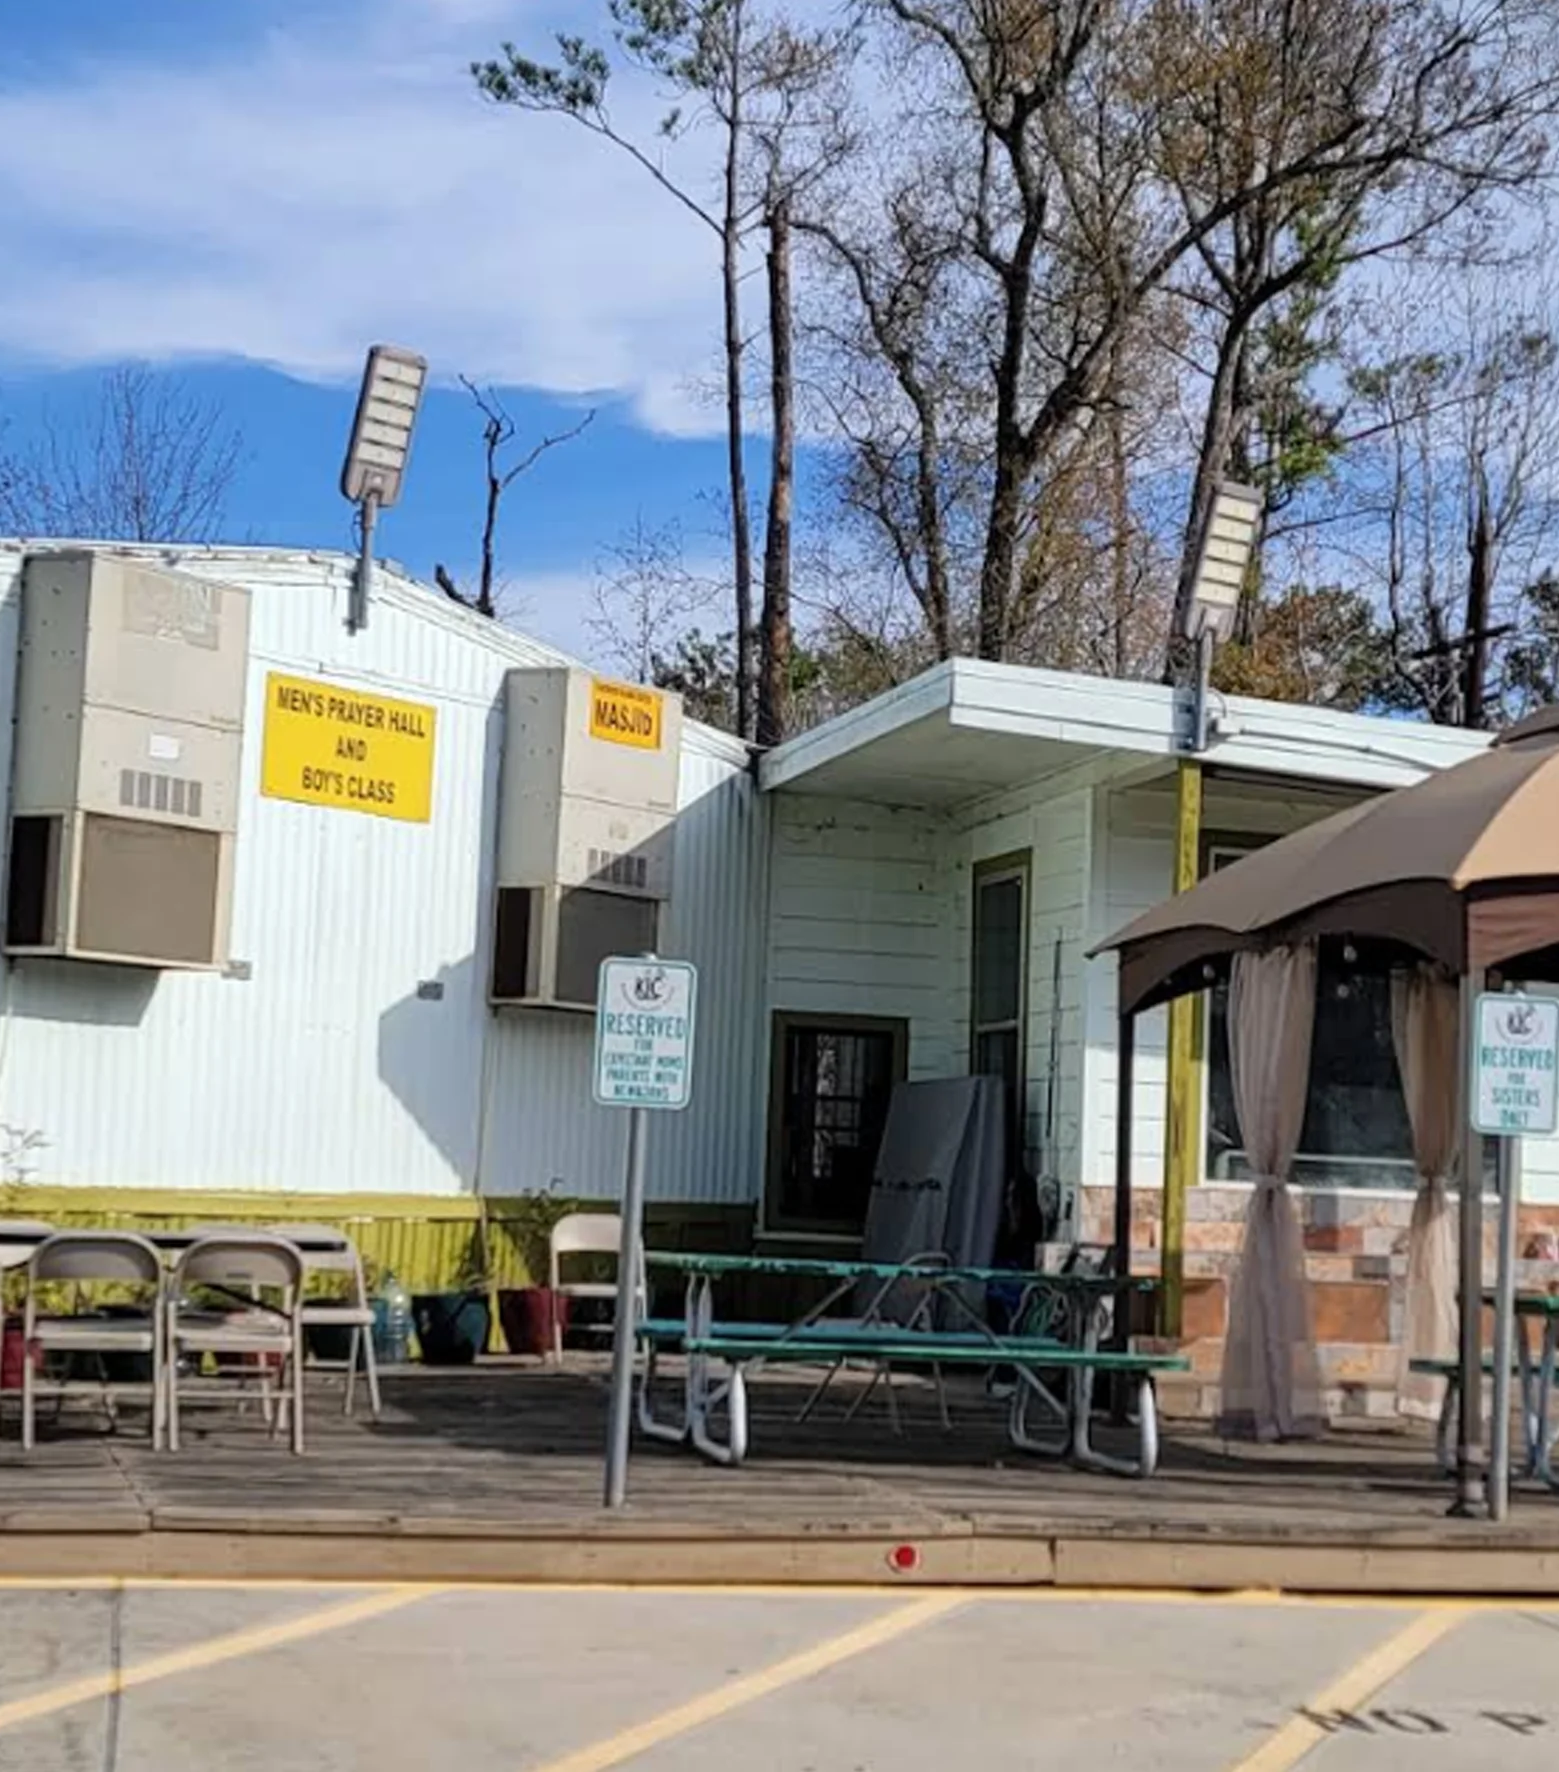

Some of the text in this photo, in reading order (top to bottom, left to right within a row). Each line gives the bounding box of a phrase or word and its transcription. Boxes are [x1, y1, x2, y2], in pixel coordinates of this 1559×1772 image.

[277, 686, 425, 739] MEN'S PRAYER HALL
[595, 699, 653, 737] MASJID
[336, 735, 368, 762] AND
[302, 766, 395, 804] BOY'S CLASS
[606, 1013, 688, 1039] RESERVED
[1482, 1046, 1554, 1071] RESERVED
[1292, 1706, 1450, 1734] NO
